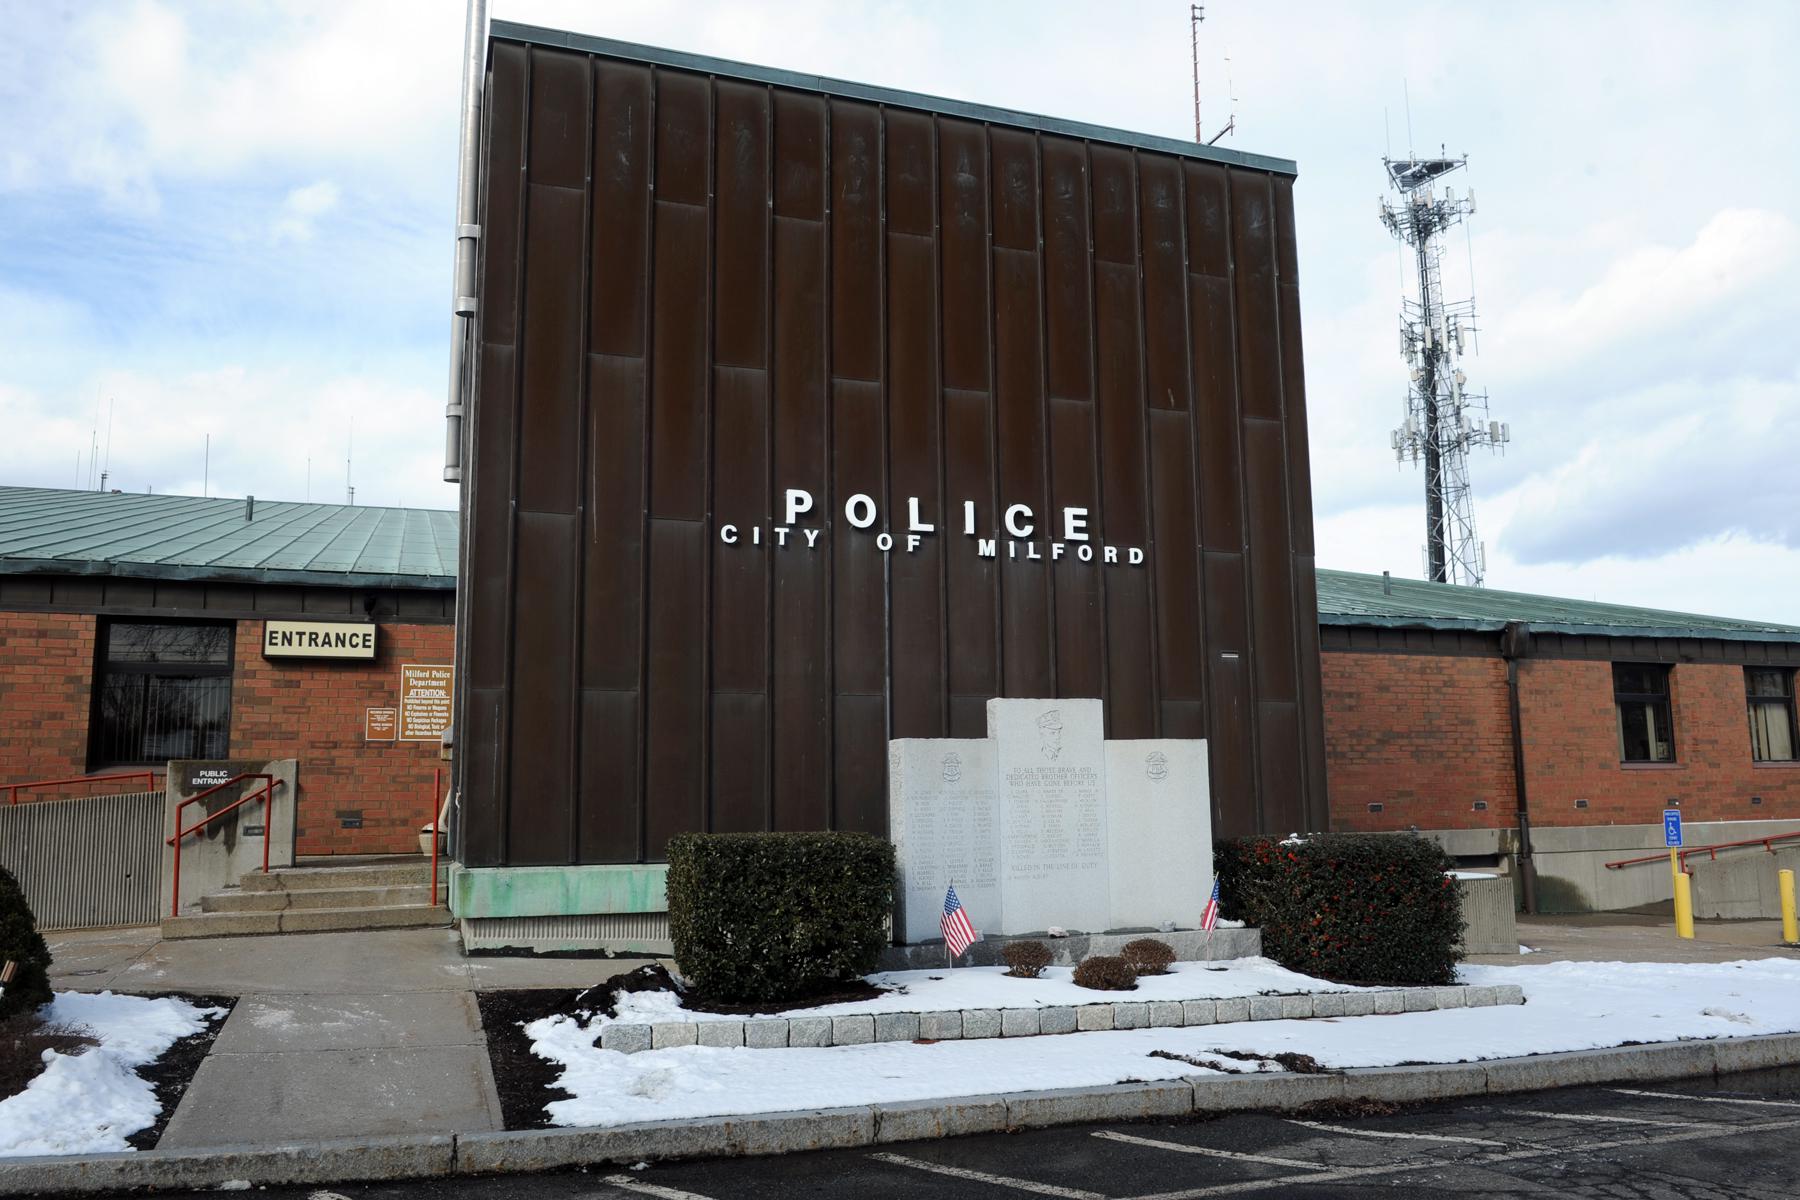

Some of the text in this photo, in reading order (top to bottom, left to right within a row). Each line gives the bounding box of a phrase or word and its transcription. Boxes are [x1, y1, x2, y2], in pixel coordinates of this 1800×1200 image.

[785, 488, 1089, 541] POLICE
[720, 524, 1144, 564] CITY OF MILFORD
[268, 629, 373, 650] ENTRANCE
[405, 670, 451, 678] Milford Police
[409, 678, 446, 687] Department
[409, 688, 448, 697] ATTENTION:
[192, 777, 233, 785] ENTRANC
